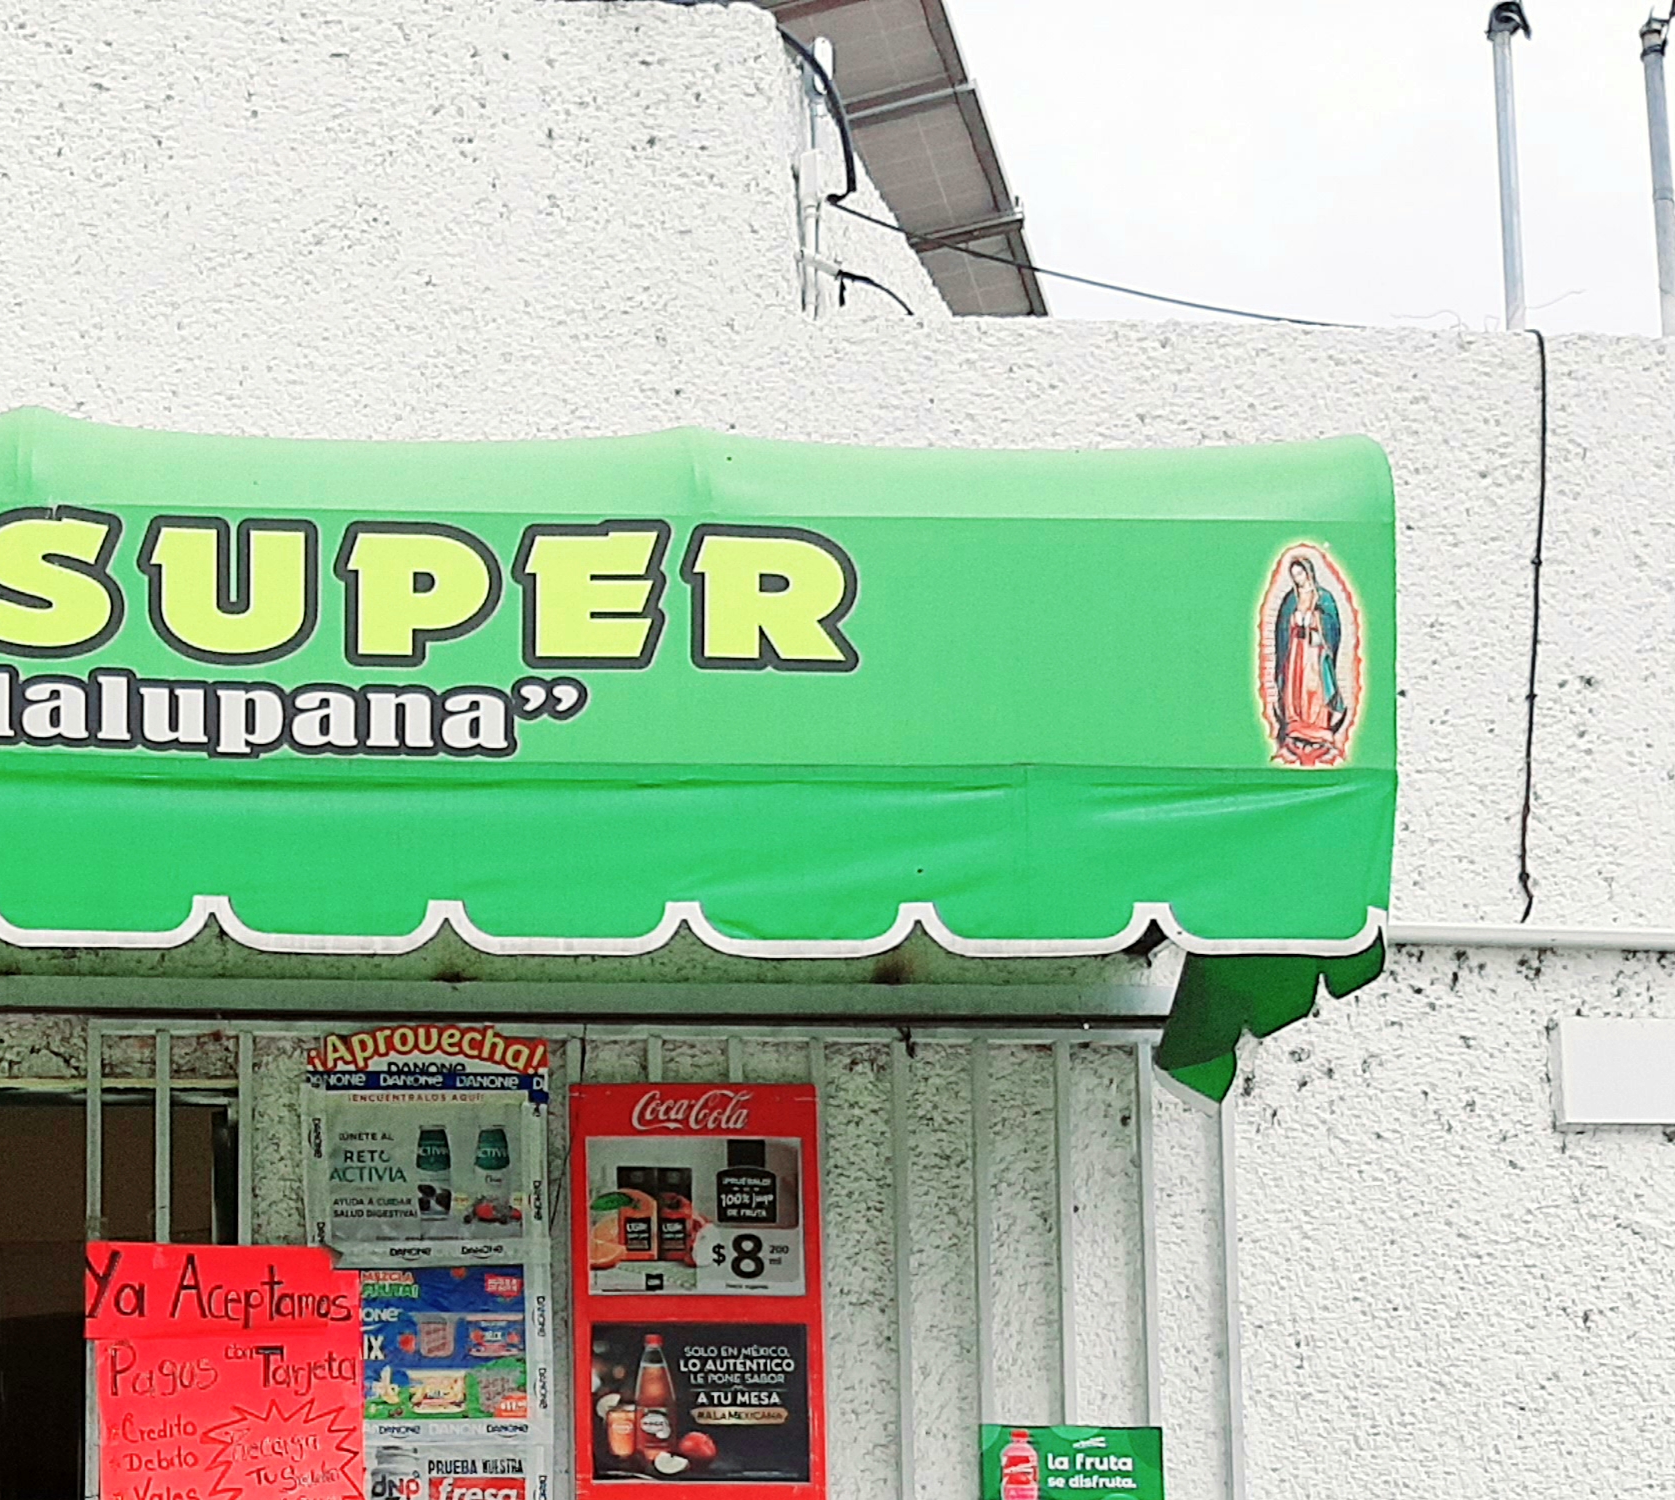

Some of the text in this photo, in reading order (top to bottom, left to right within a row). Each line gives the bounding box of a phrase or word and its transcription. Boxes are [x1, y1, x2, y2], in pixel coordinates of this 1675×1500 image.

[632, 1090, 754, 1131] Coca-Cola
[329, 1167, 407, 1183] ACTIVIA
[86, 1249, 352, 1329] Ya Aceptamos
[685, 1347, 717, 1357] SOLO
[721, 1346, 738, 1357] EN
[106, 1340, 218, 1399] Pagos
[254, 1344, 357, 1396] Tarjeta
[680, 1359, 700, 1371] LO
[690, 1374, 785, 1384] LE PONE SABOR
[696, 1391, 781, 1405] A TU MESA
[428, 1460, 477, 1474] PRUEBA
[1047, 1453, 1068, 1470] la
[1075, 1453, 1133, 1471] fruta
[1047, 1477, 1065, 1488] se
